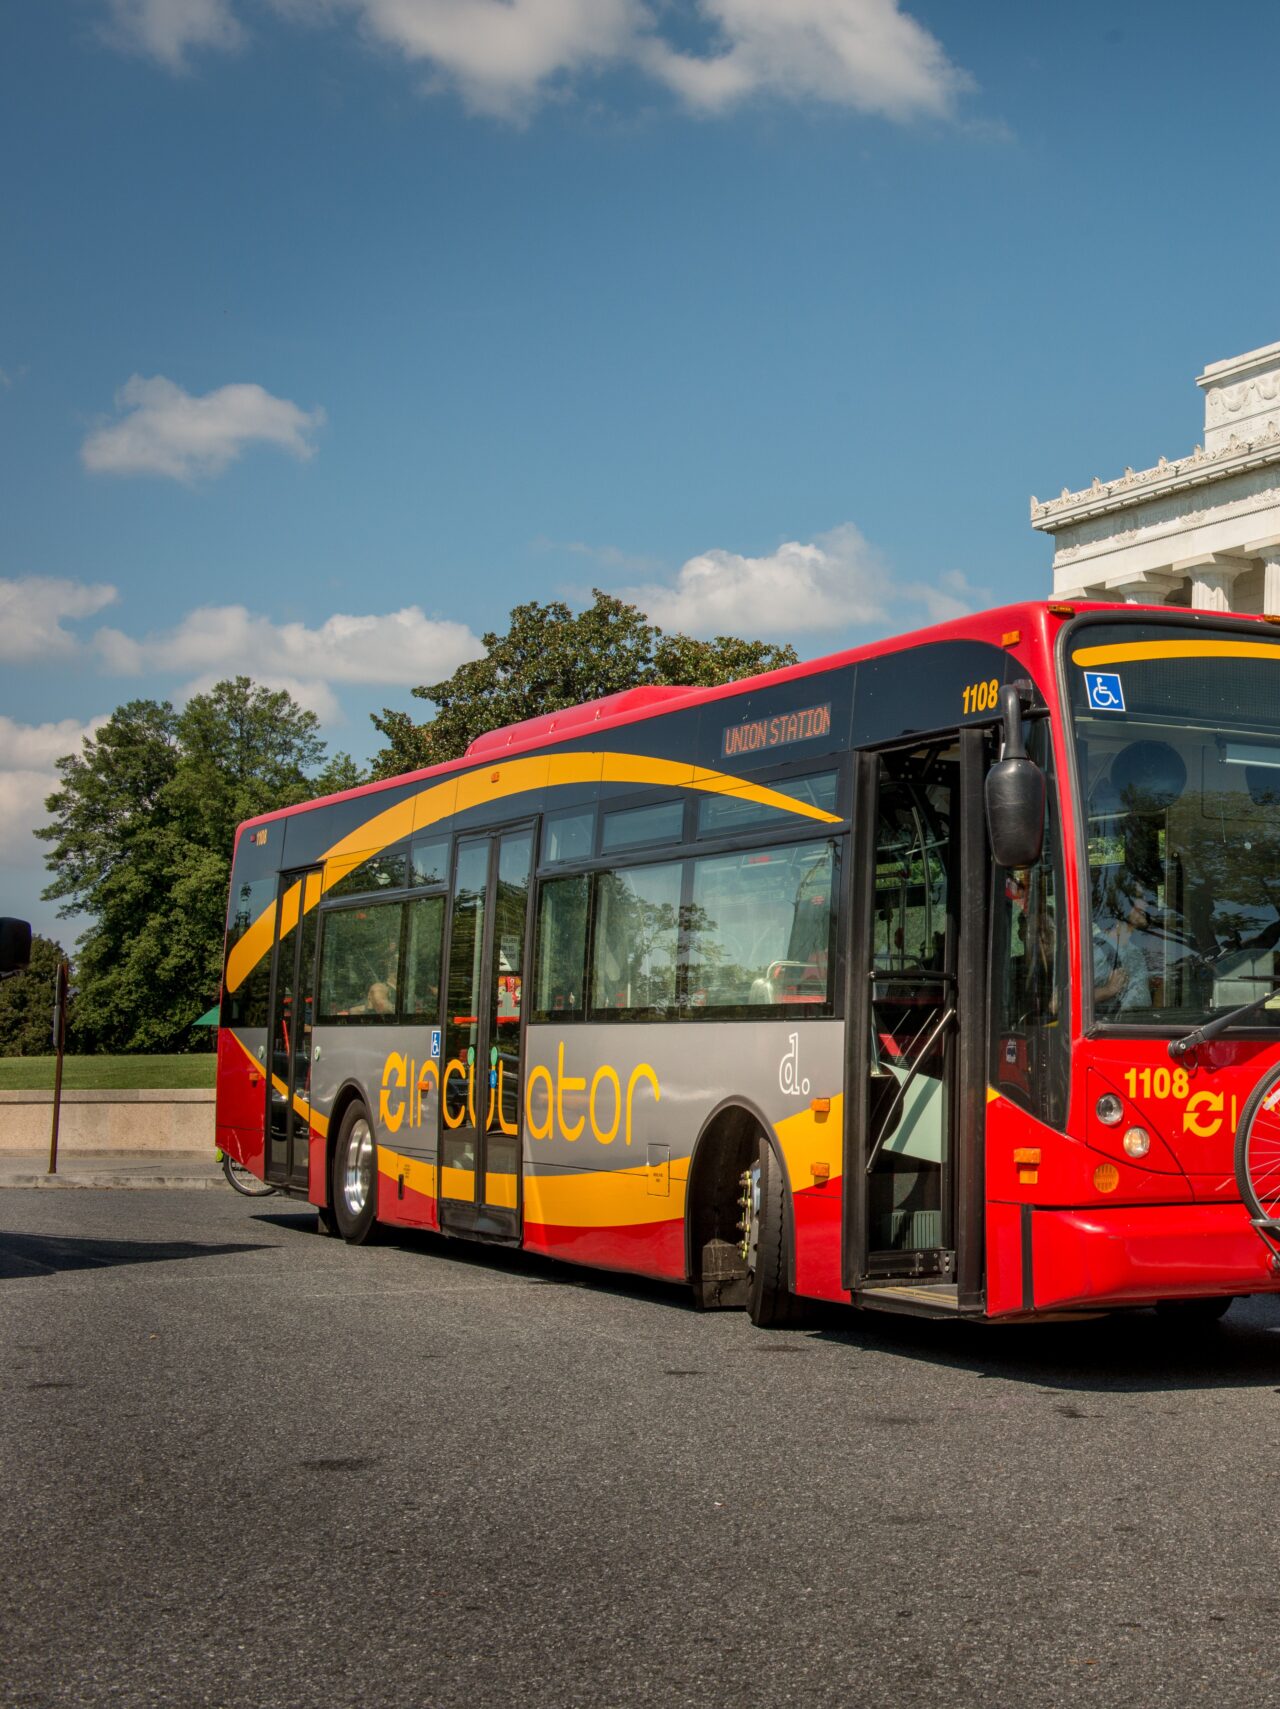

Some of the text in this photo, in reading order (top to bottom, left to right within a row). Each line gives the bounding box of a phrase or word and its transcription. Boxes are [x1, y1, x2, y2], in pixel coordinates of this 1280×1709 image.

[963, 679, 999, 714] 1108
[725, 704, 831, 755] UNION STATION
[1124, 1067, 1190, 1099] 1108
